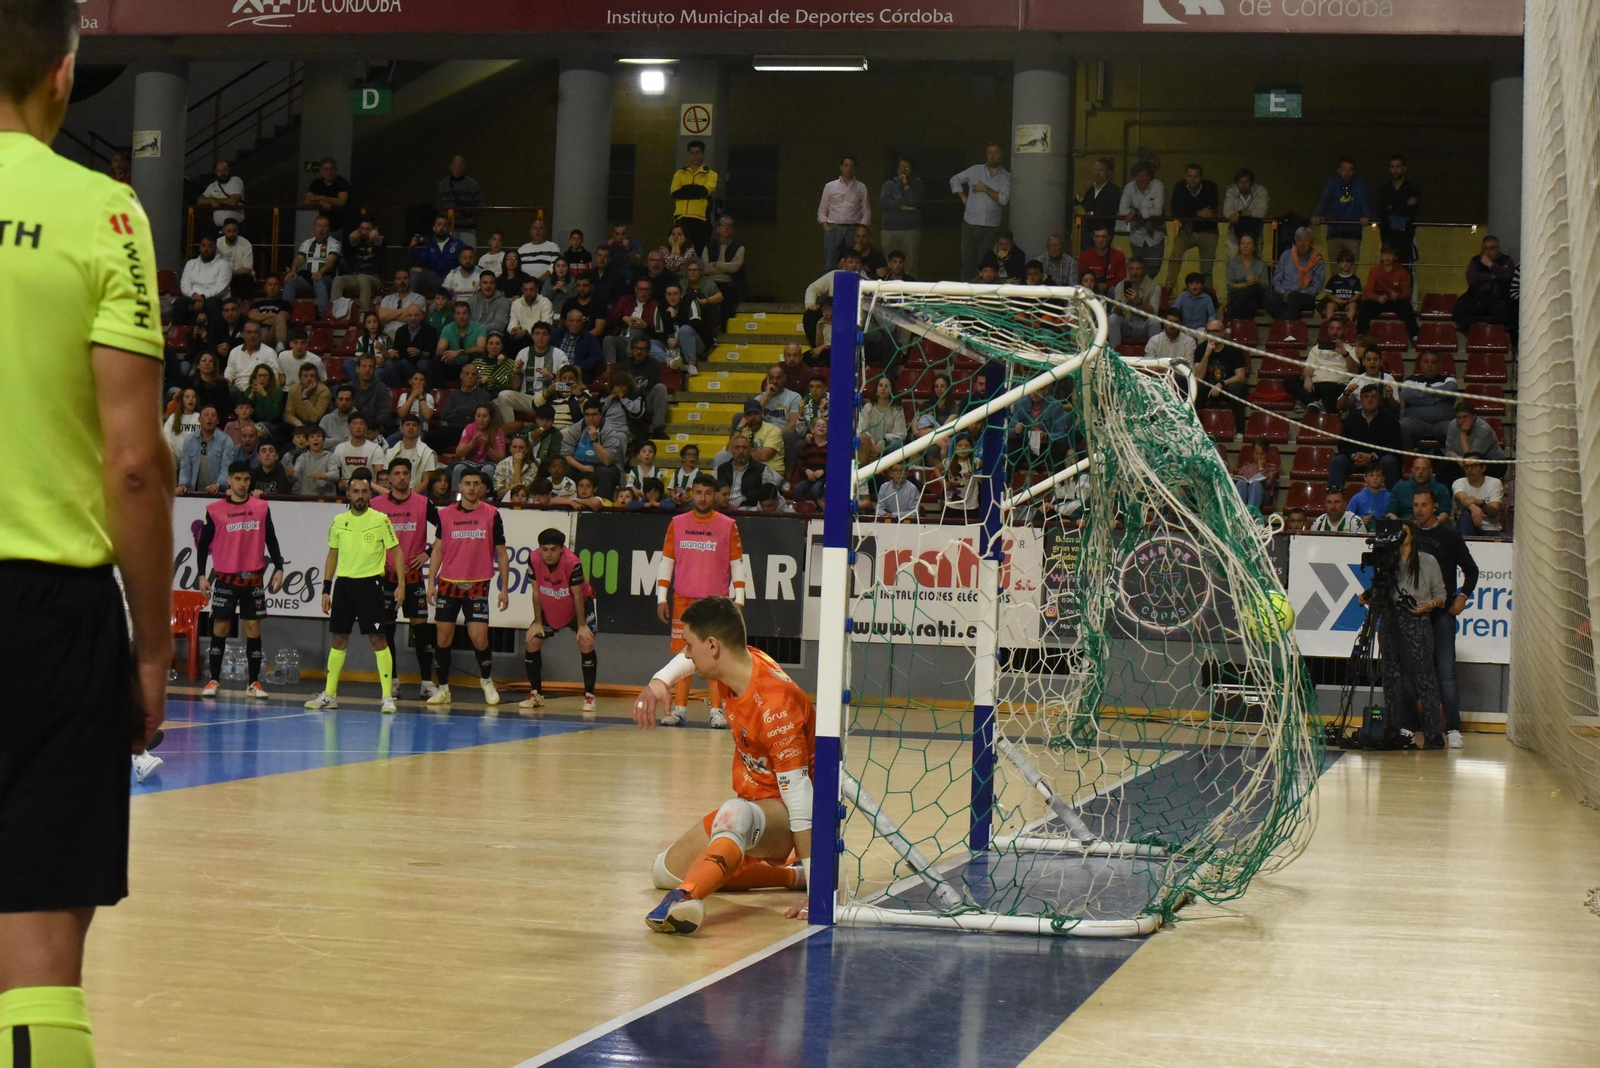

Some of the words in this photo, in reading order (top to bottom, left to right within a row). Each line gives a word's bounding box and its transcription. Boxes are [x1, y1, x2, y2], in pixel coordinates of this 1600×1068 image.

[606, 9, 676, 24] Instituto
[679, 8, 764, 27] Municipal
[768, 8, 791, 24] de
[794, 8, 875, 27] Deportes
[878, 7, 955, 24] Córdoba
[361, 88, 381, 110] D
[1268, 89, 1288, 113] E
[451, 529, 487, 539] wanapix
[679, 540, 717, 551] wanapix
[1140, 605, 1188, 620] COPAS
[851, 620, 978, 639] www.rahi.e
